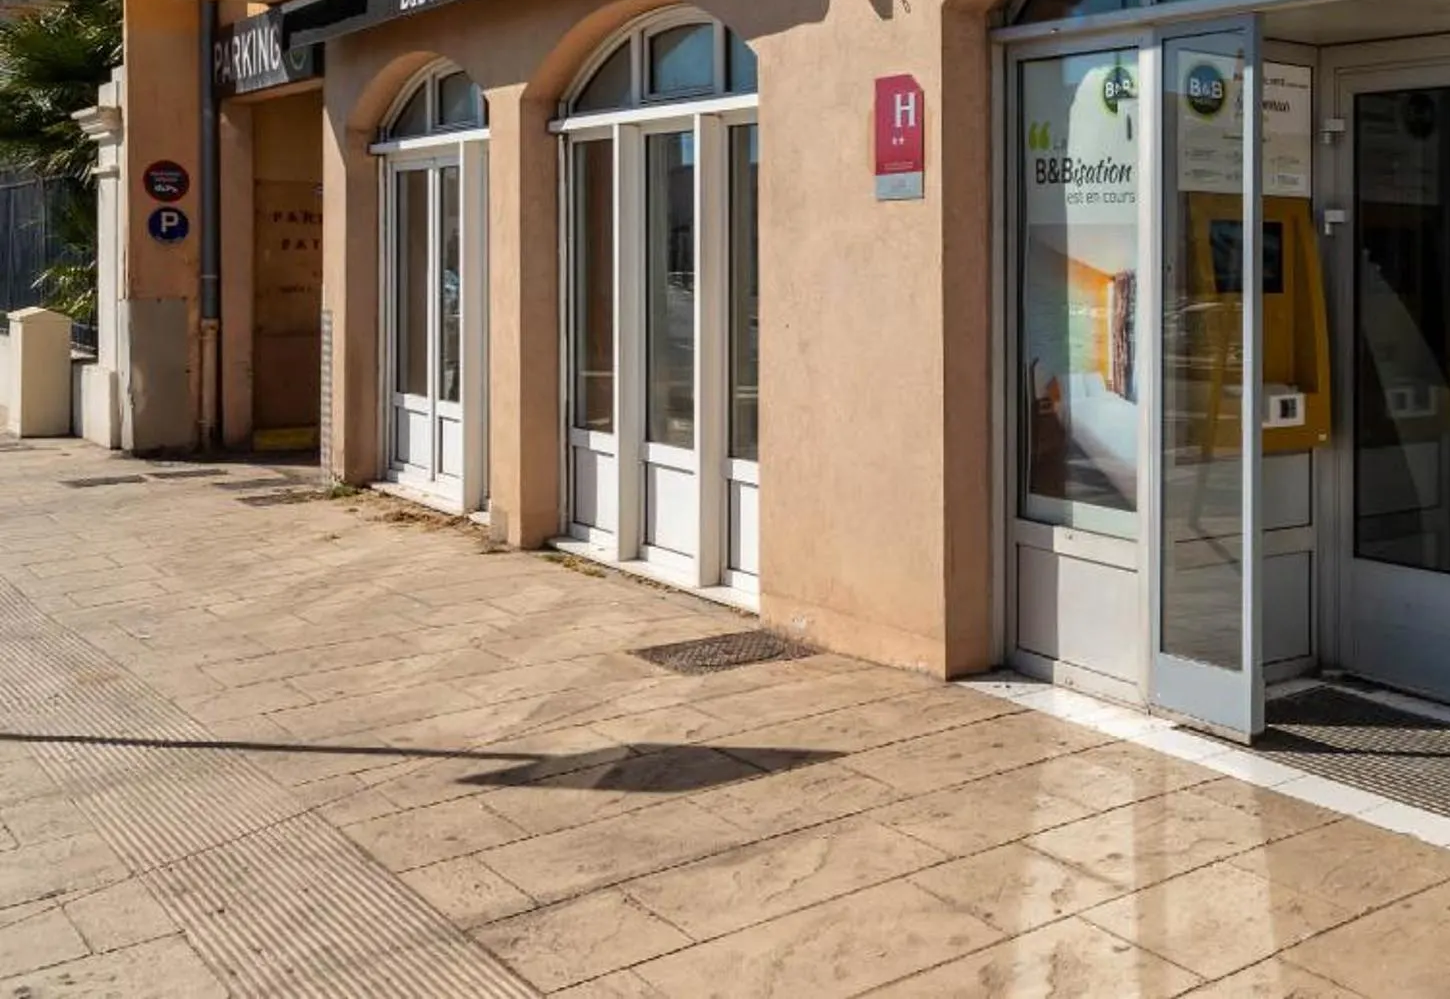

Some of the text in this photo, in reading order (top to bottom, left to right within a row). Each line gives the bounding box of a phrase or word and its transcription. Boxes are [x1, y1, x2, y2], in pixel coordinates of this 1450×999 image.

[213, 24, 281, 83] PARKING
[894, 91, 916, 128] H
[160, 211, 179, 234] P
